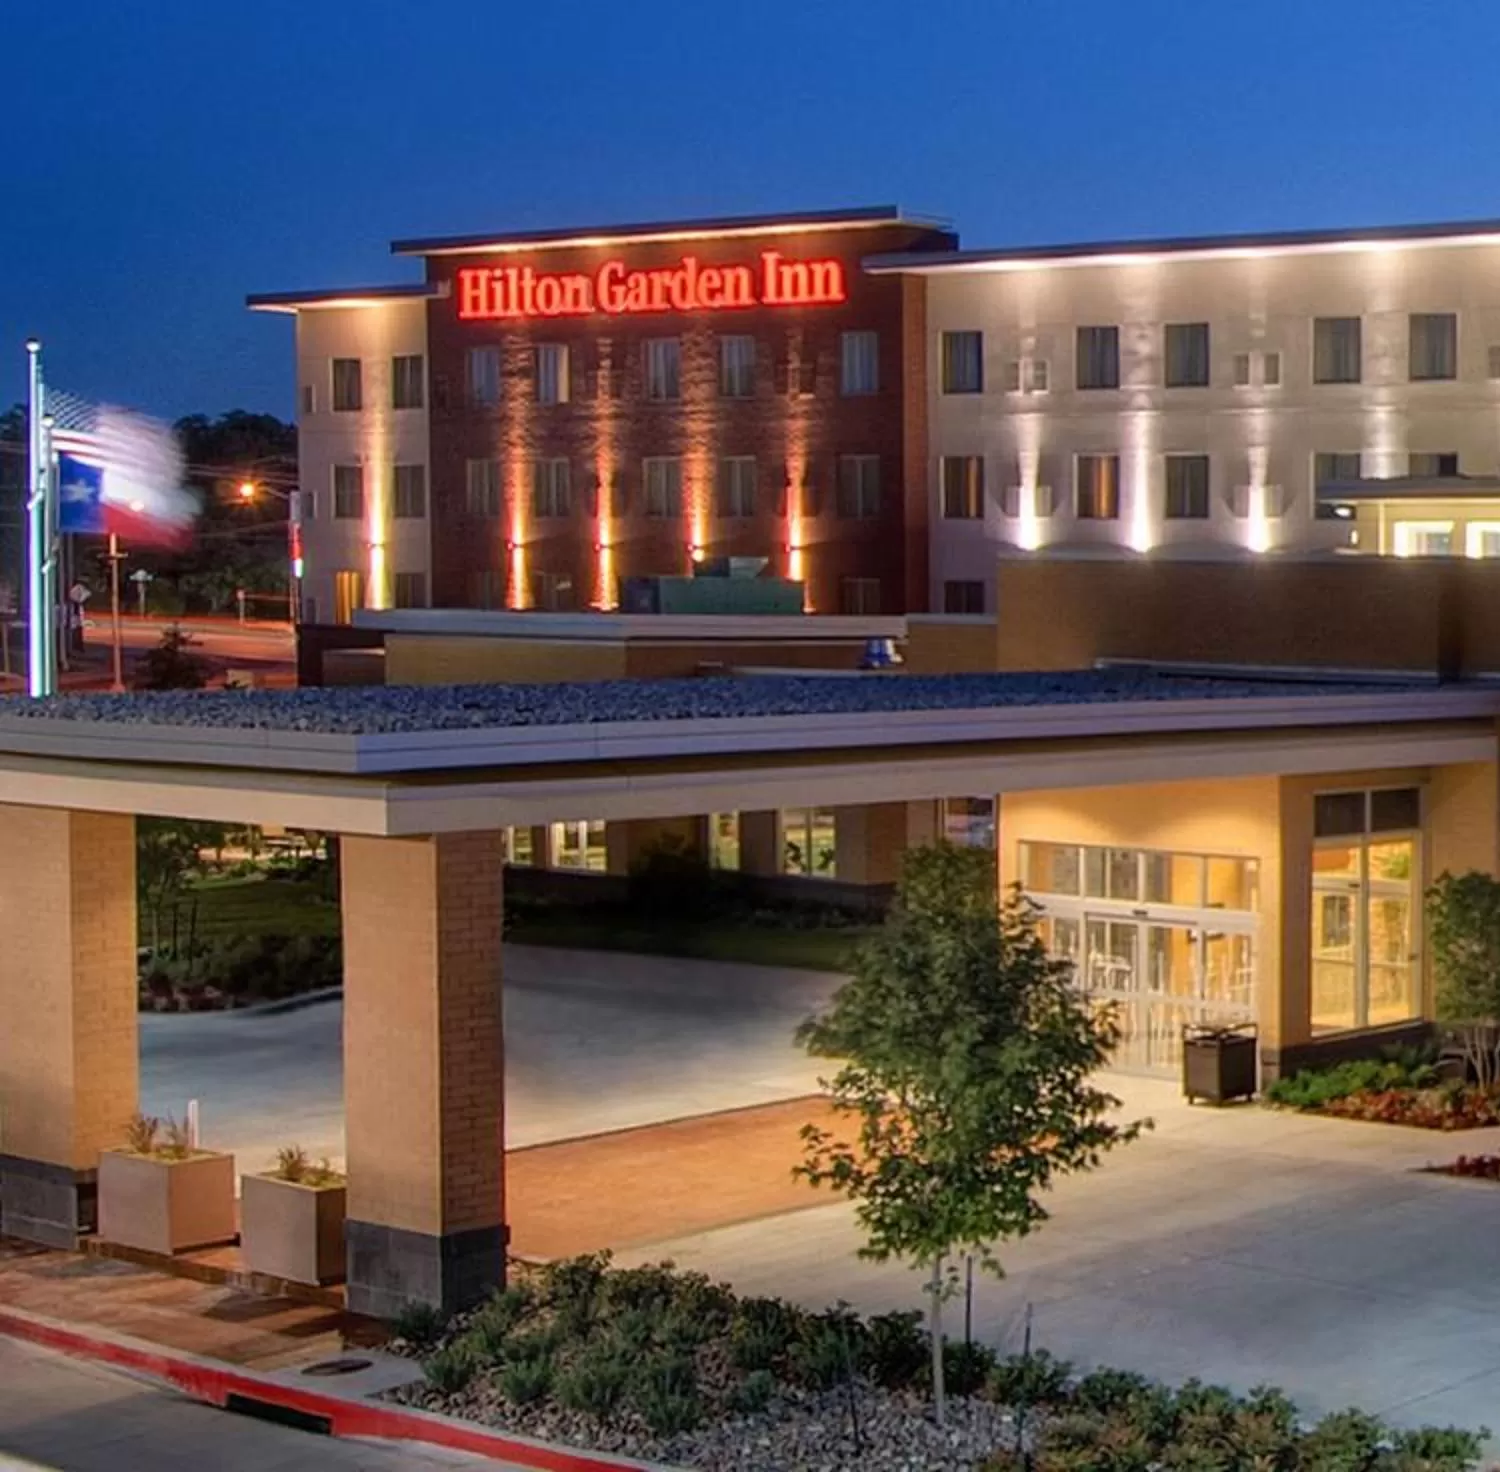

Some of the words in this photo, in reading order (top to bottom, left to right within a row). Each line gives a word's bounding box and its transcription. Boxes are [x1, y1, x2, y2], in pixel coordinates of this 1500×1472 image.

[457, 266, 597, 319] Hilton
[598, 256, 758, 313] Garden
[760, 251, 845, 305] Inn
